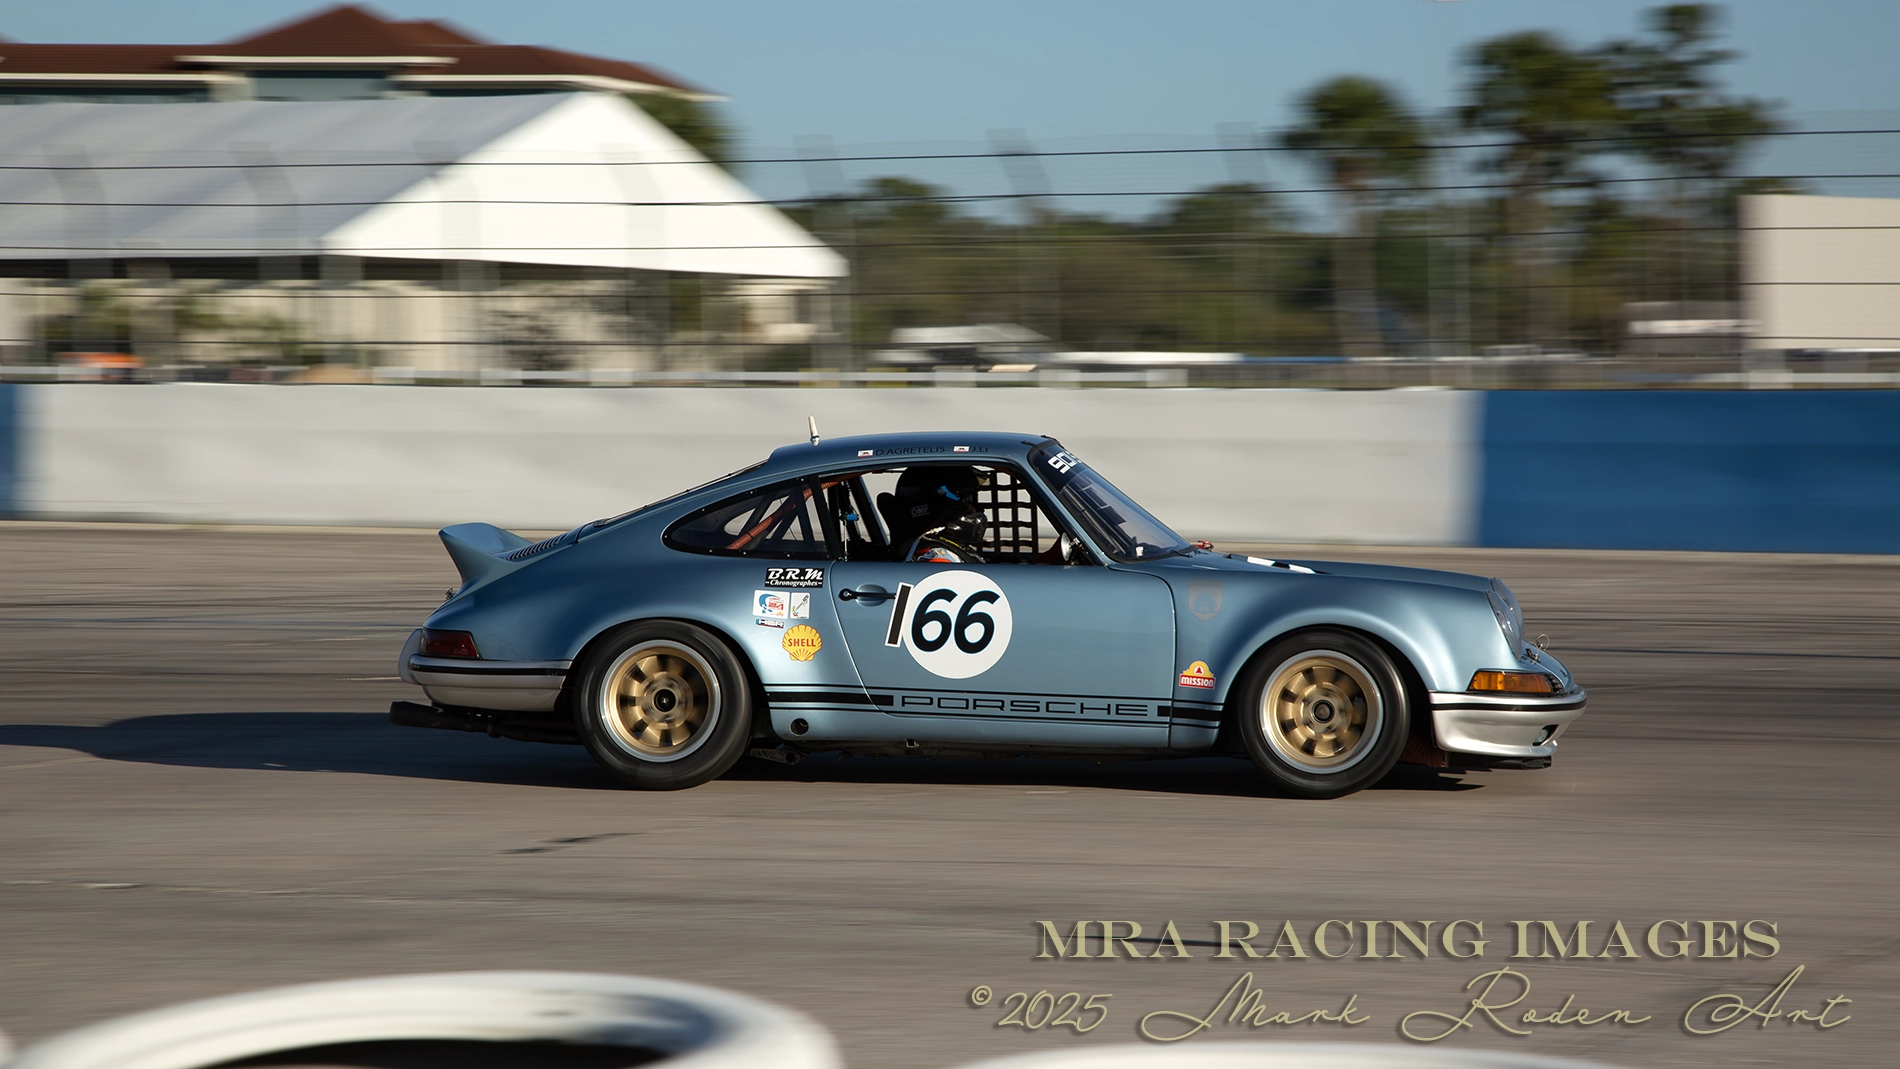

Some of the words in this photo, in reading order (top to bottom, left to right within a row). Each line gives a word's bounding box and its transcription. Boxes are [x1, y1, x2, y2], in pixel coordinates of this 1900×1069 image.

[875, 446, 945, 456] D.AGRETELIS
[911, 506, 929, 516] OMP
[887, 584, 1001, 654] 166
[787, 638, 816, 647] SHELL
[901, 695, 1148, 717] PORSCHE
